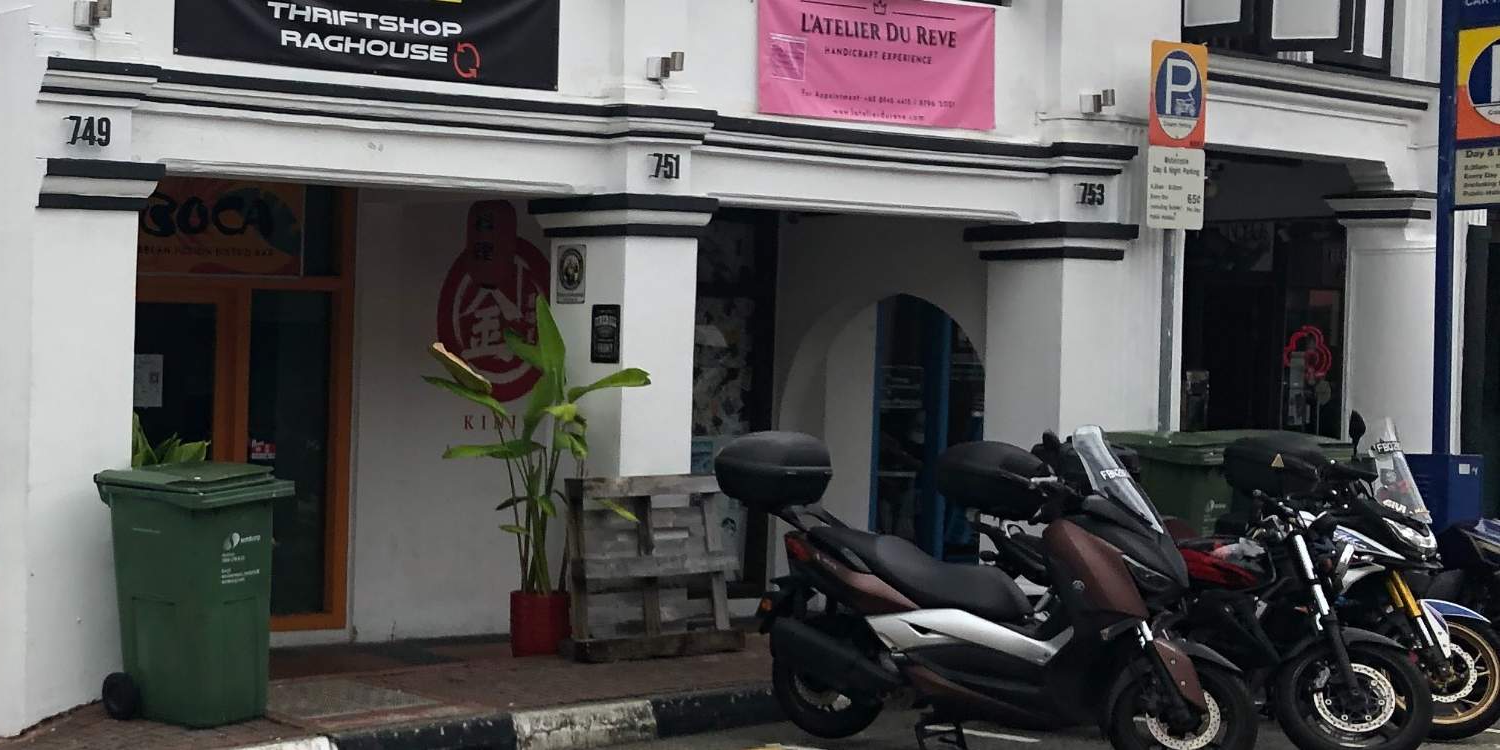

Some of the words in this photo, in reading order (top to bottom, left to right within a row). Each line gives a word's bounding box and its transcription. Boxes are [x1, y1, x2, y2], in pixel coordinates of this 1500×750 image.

[267, 1, 463, 37] THRIFTSHOP
[280, 29, 448, 63] RAGHOUSE
[824, 46, 878, 60] HANDICRAFT
[881, 52, 933, 65] EXPERIENCE
[66, 115, 111, 147] 749
[651, 153, 680, 179] 751
[1465, 150, 1484, 159] Day
[1075, 183, 1105, 206] 753
